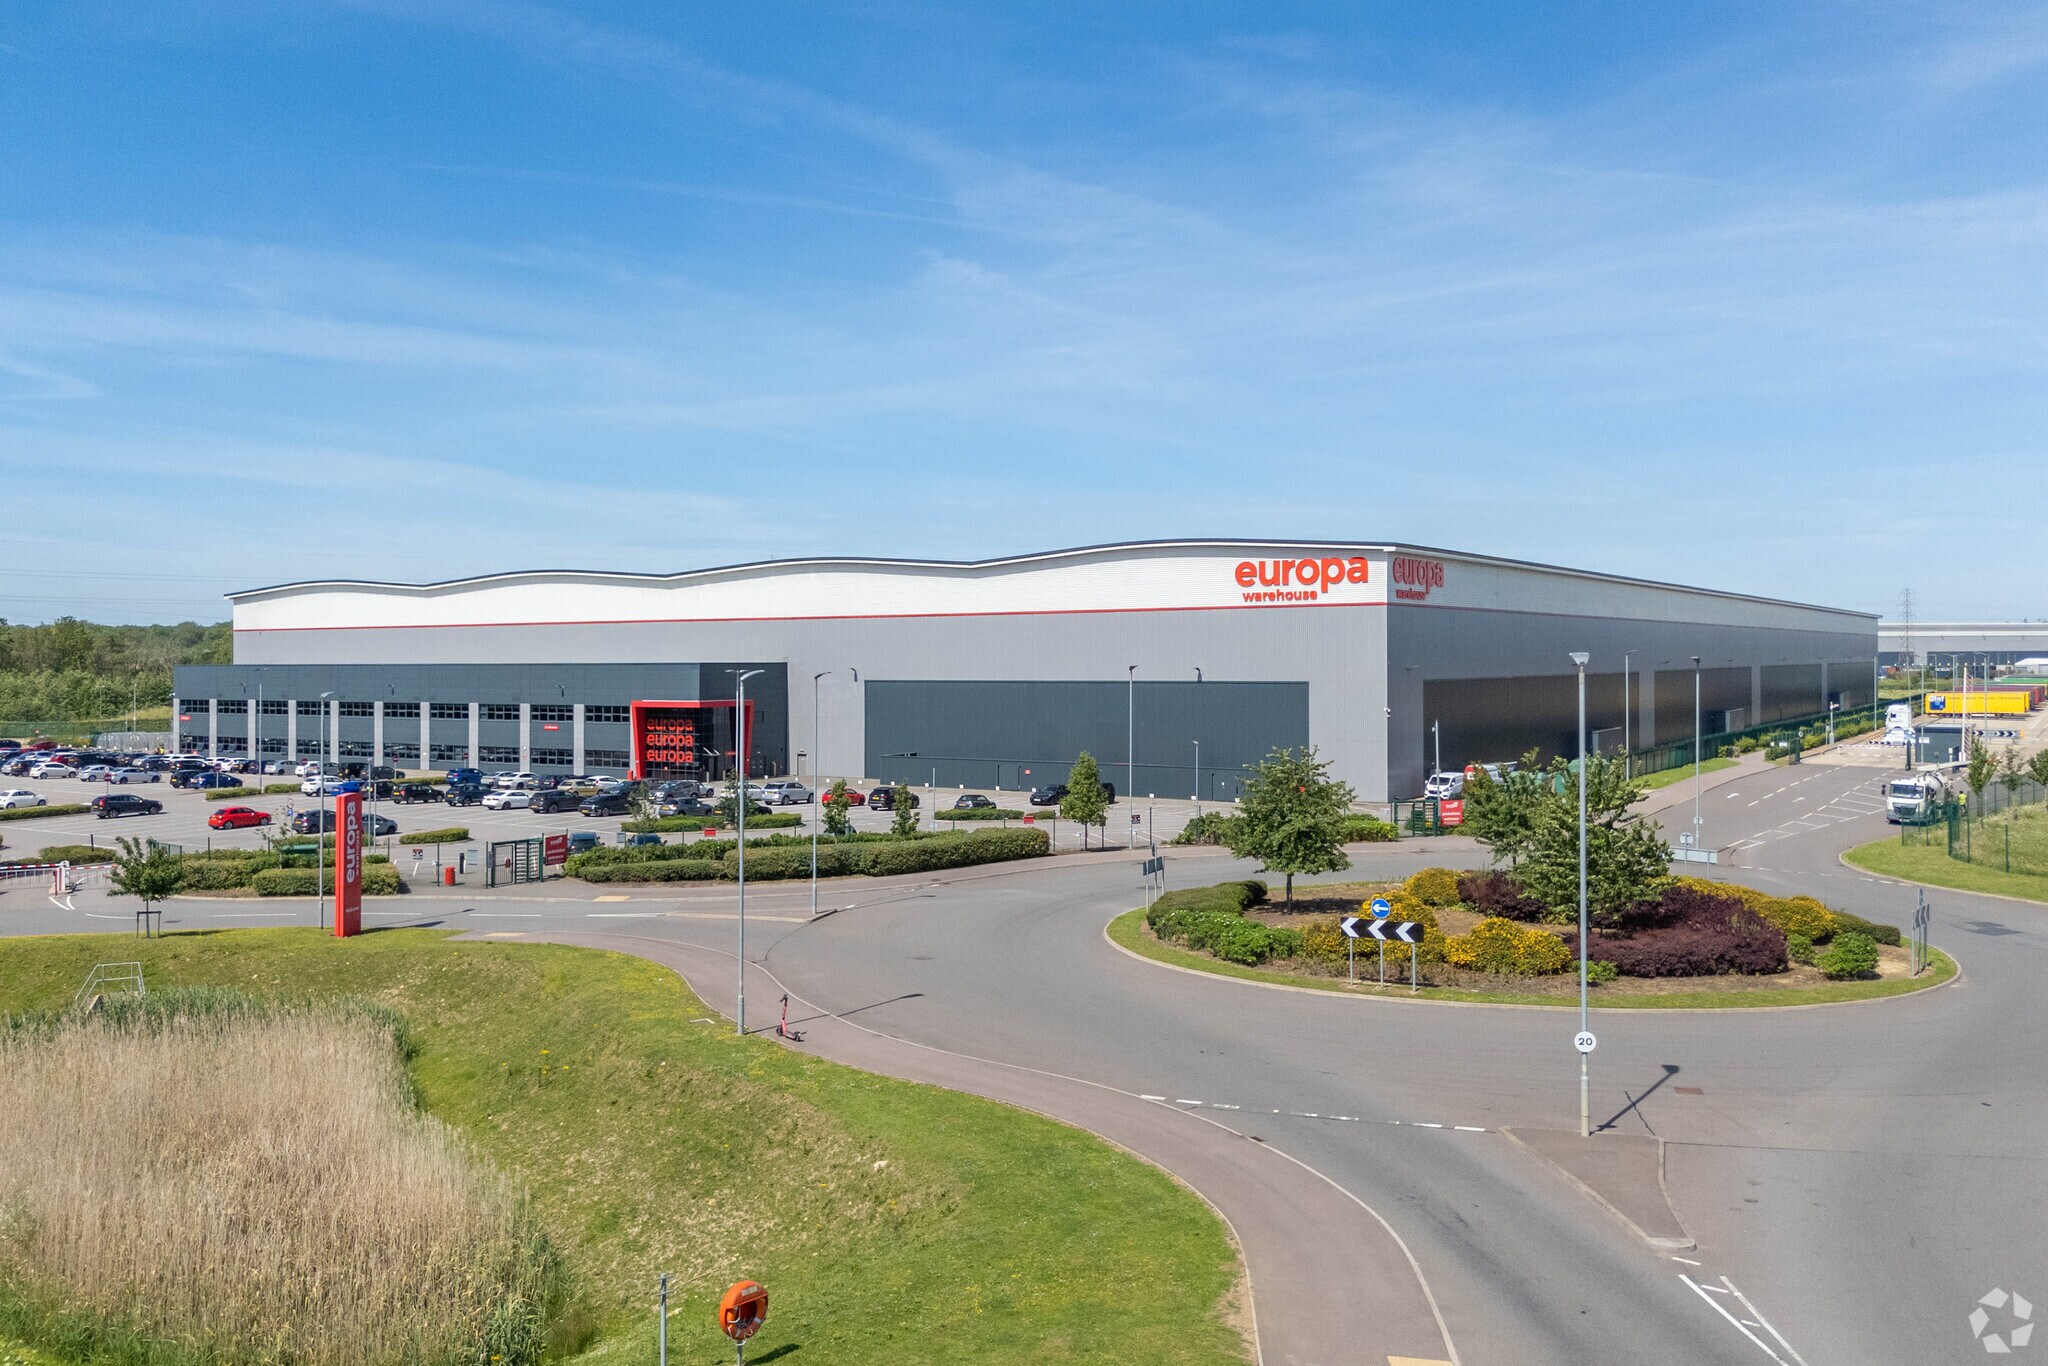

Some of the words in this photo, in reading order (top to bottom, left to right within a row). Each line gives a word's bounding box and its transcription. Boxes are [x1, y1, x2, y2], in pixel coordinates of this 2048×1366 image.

[1235, 556, 1369, 593] europa
[1393, 556, 1444, 594] europa
[1242, 588, 1318, 602] warehouse
[646, 718, 693, 733] europa
[646, 733, 693, 750] europa
[646, 749, 693, 766] europa
[347, 801, 358, 883] europa
[1578, 1037, 1593, 1046] 20
